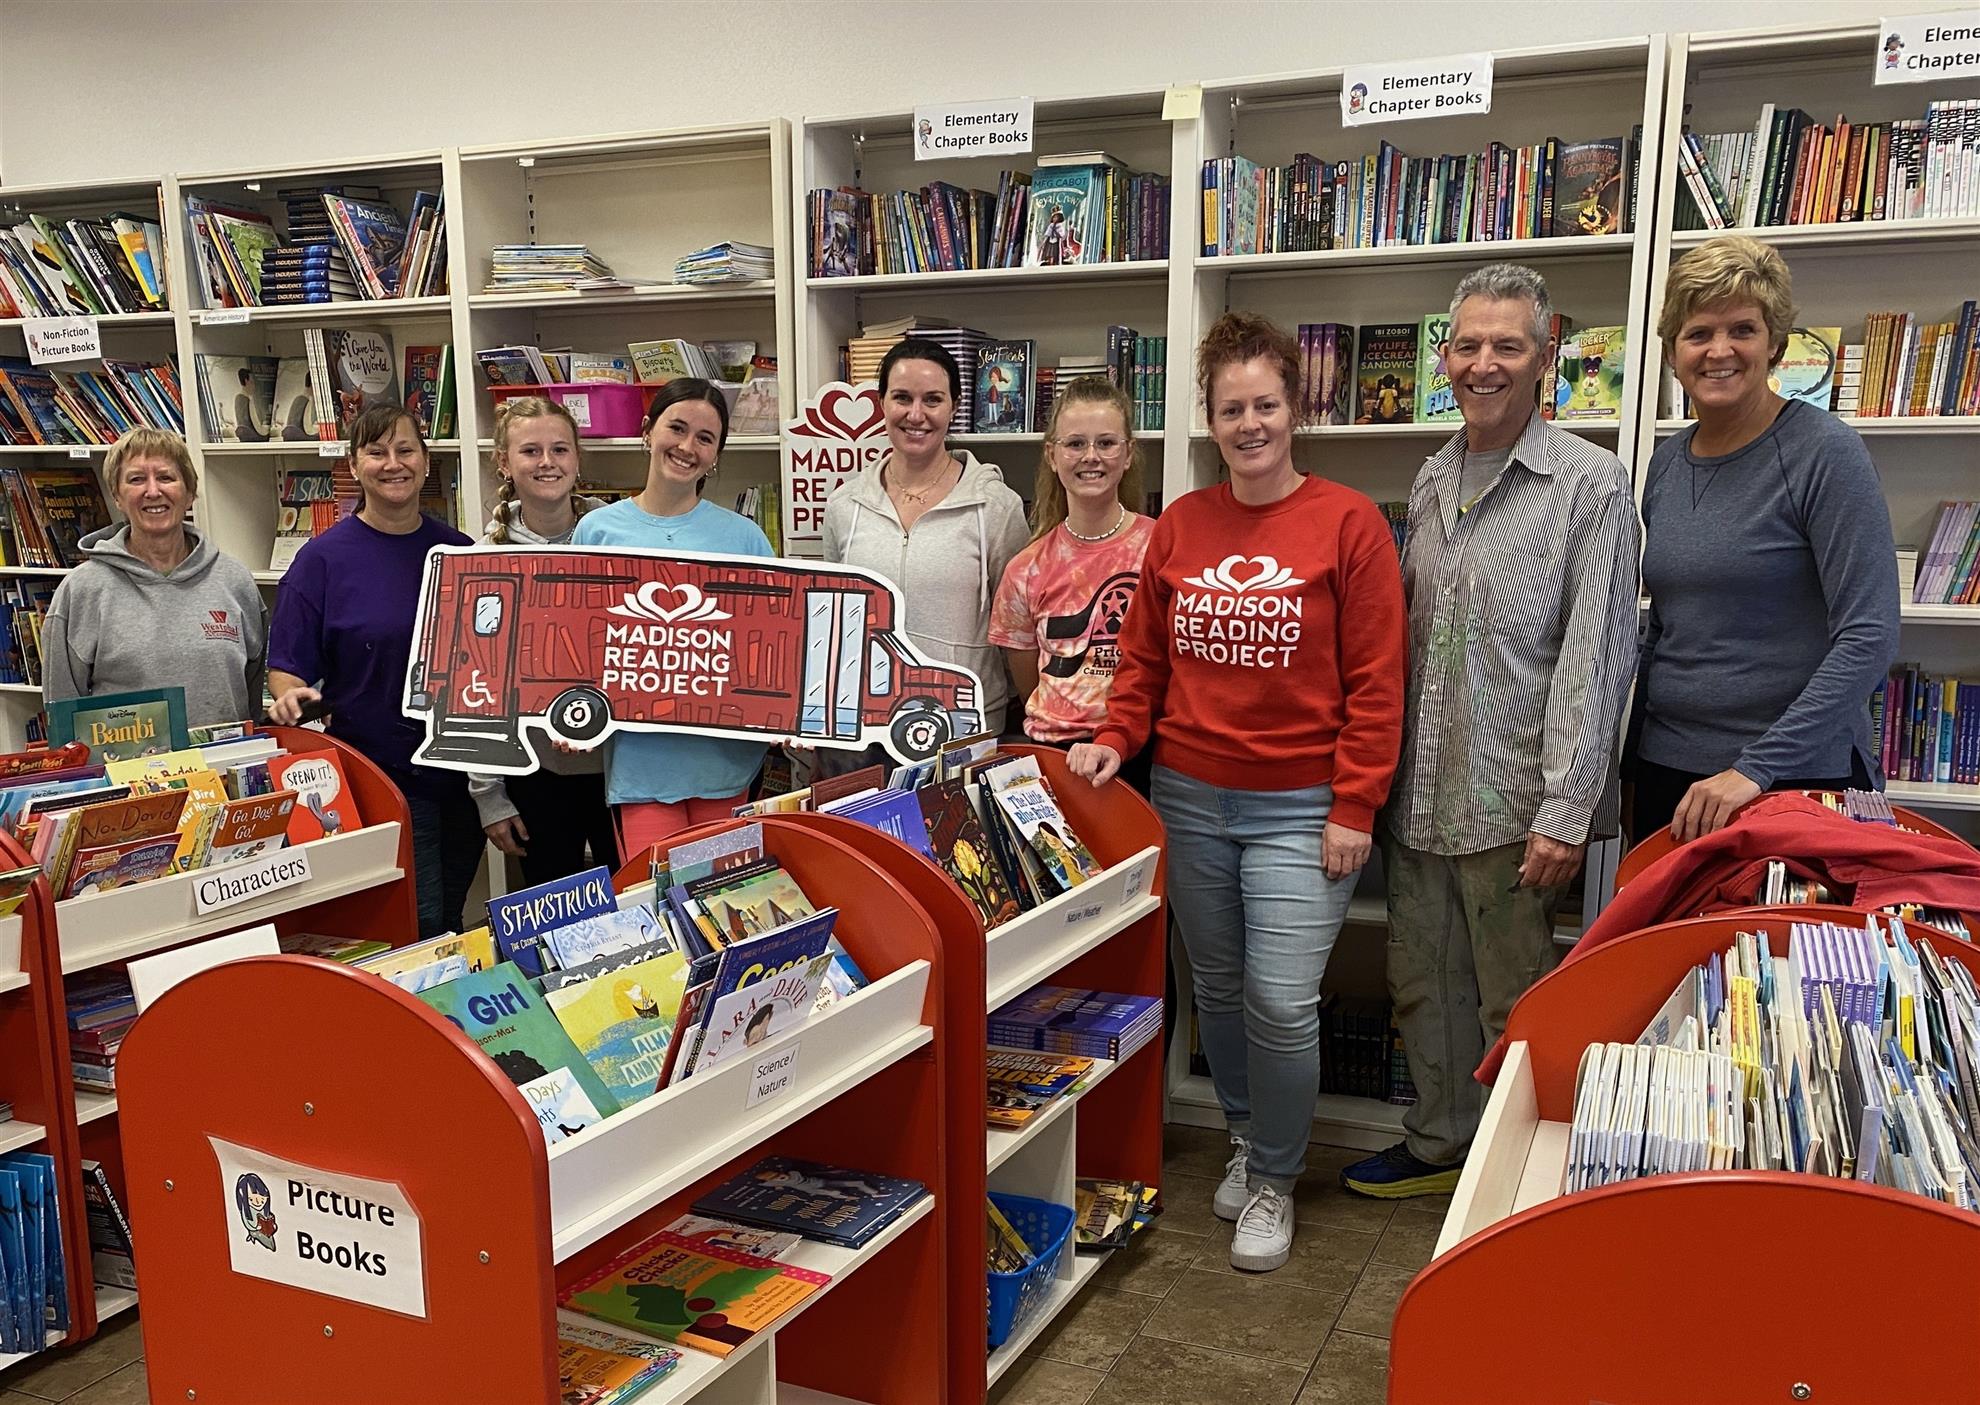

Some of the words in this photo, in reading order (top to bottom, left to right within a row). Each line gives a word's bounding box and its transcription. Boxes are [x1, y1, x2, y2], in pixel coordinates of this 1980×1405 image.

[1382, 71, 1473, 91] Elementary
[1369, 98, 1431, 115] Chapter
[1435, 91, 1483, 108] Books
[944, 112, 1019, 127] Elementary
[934, 135, 986, 149] Chapter
[988, 130, 1028, 144] Books
[1055, 177, 1088, 186] CABOT
[43, 327, 89, 341] Non-Fiction
[1368, 342, 1385, 350] MY
[1386, 341, 1407, 350] LIFE
[41, 345, 71, 357] Picture
[71, 342, 96, 353] Books
[352, 340, 369, 355] Give
[368, 340, 384, 359] You
[1363, 352, 1382, 360] ICE
[360, 358, 390, 375] World
[1361, 361, 1417, 370] SANDWIC
[1176, 590, 1303, 619] MADISON
[606, 623, 732, 651] MADISON
[1174, 614, 1301, 643] READING
[603, 646, 731, 673] READING
[1177, 637, 1297, 669] PROJECT
[602, 670, 730, 697] PROJECT
[90, 717, 156, 747] Bambi
[286, 768, 317, 786] SPEND
[318, 764, 332, 780] IT!
[192, 788, 216, 801] Bird
[1007, 795, 1028, 810] The
[1023, 790, 1046, 806] Little
[122, 799, 178, 832] David!
[1014, 810, 1035, 825] Blue
[235, 824, 256, 840] Go!
[200, 858, 306, 906] Characters
[501, 876, 610, 937] STARSTRUCK
[468, 982, 530, 1025] Girl
[703, 997, 757, 1062] LARA
[757, 1055, 789, 1079] Science
[992, 1053, 1043, 1064] HEAVY
[527, 1081, 562, 1104] Days
[757, 1075, 788, 1098] Nature
[287, 1179, 396, 1227] Picture
[296, 1229, 388, 1278] Books
[623, 1249, 677, 1279] Chicka
[637, 1252, 690, 1284] Chicka
